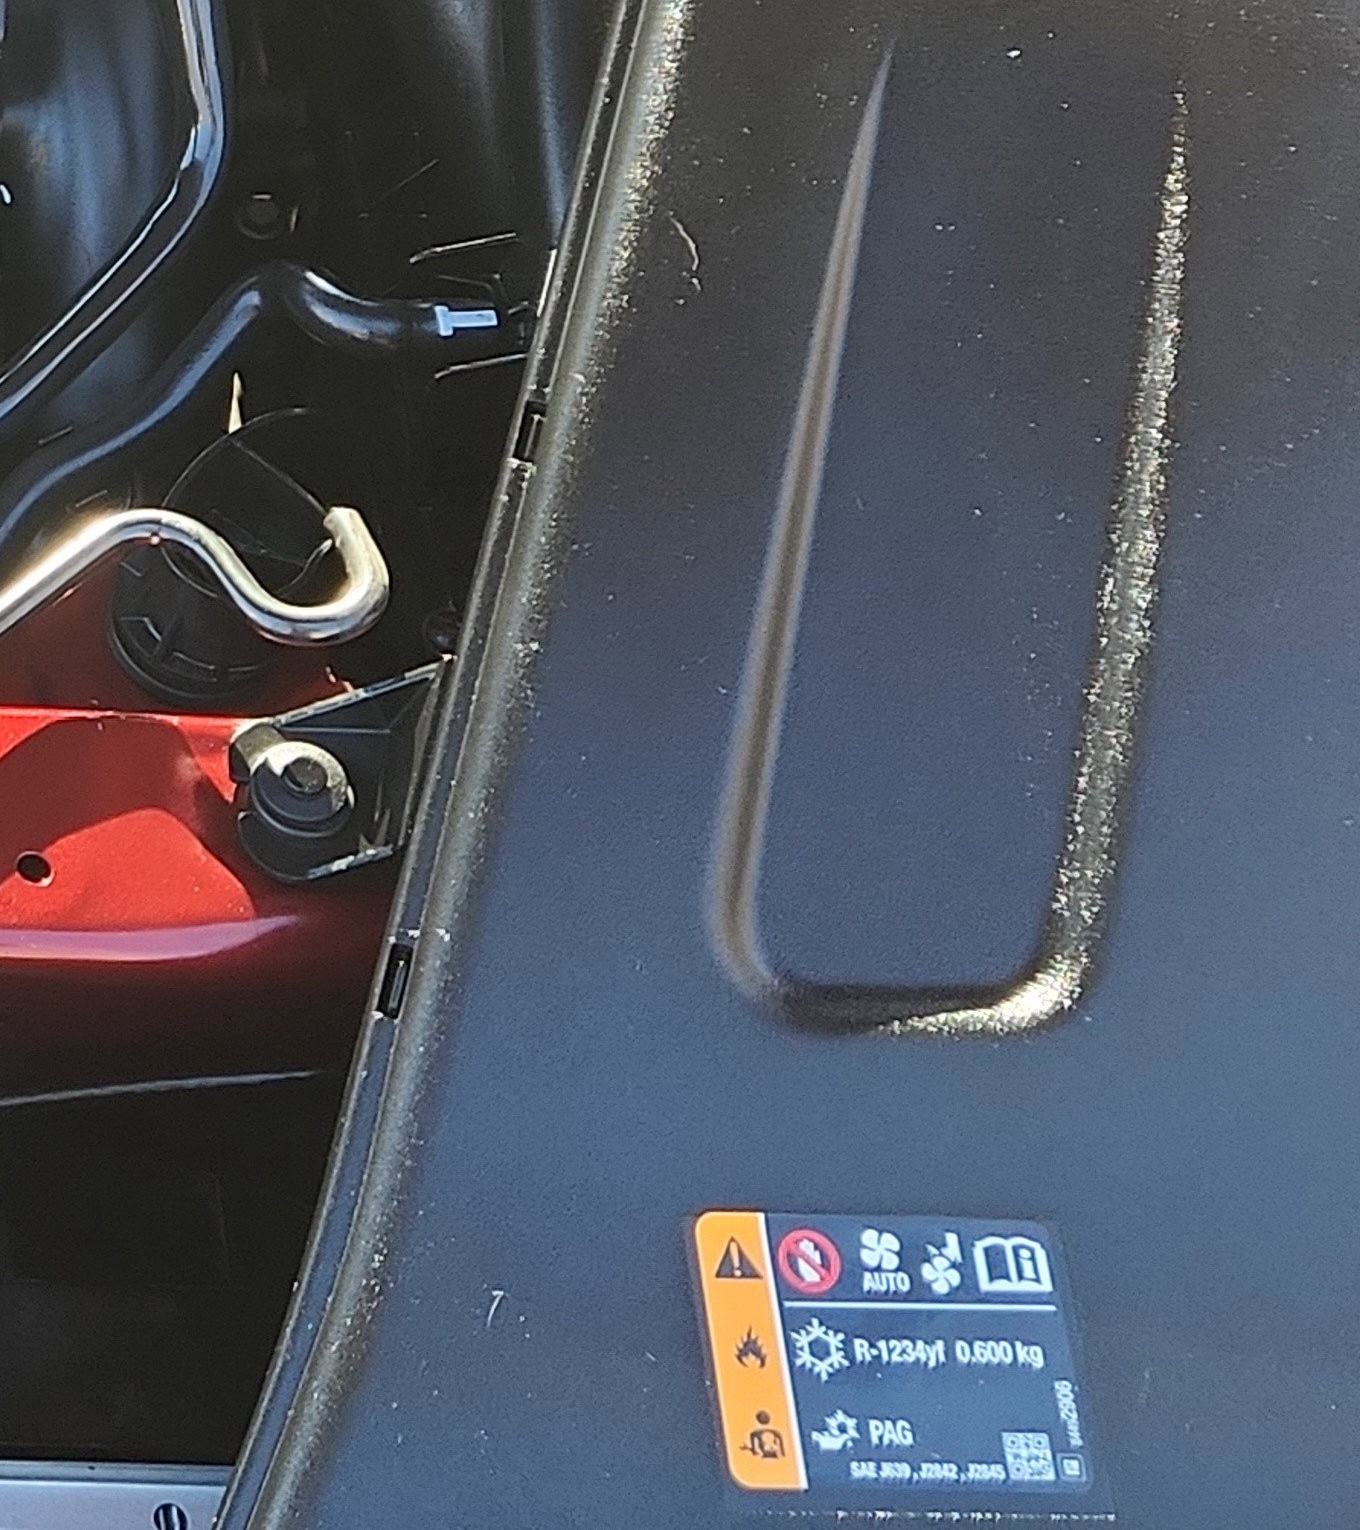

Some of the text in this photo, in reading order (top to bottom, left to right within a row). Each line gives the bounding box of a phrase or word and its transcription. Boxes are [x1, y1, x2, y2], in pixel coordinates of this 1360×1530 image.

[862, 1272, 910, 1293] AUTO
[853, 1338, 1045, 1368] R-1234yf 0.600 kg
[868, 1419, 913, 1446] PAG
